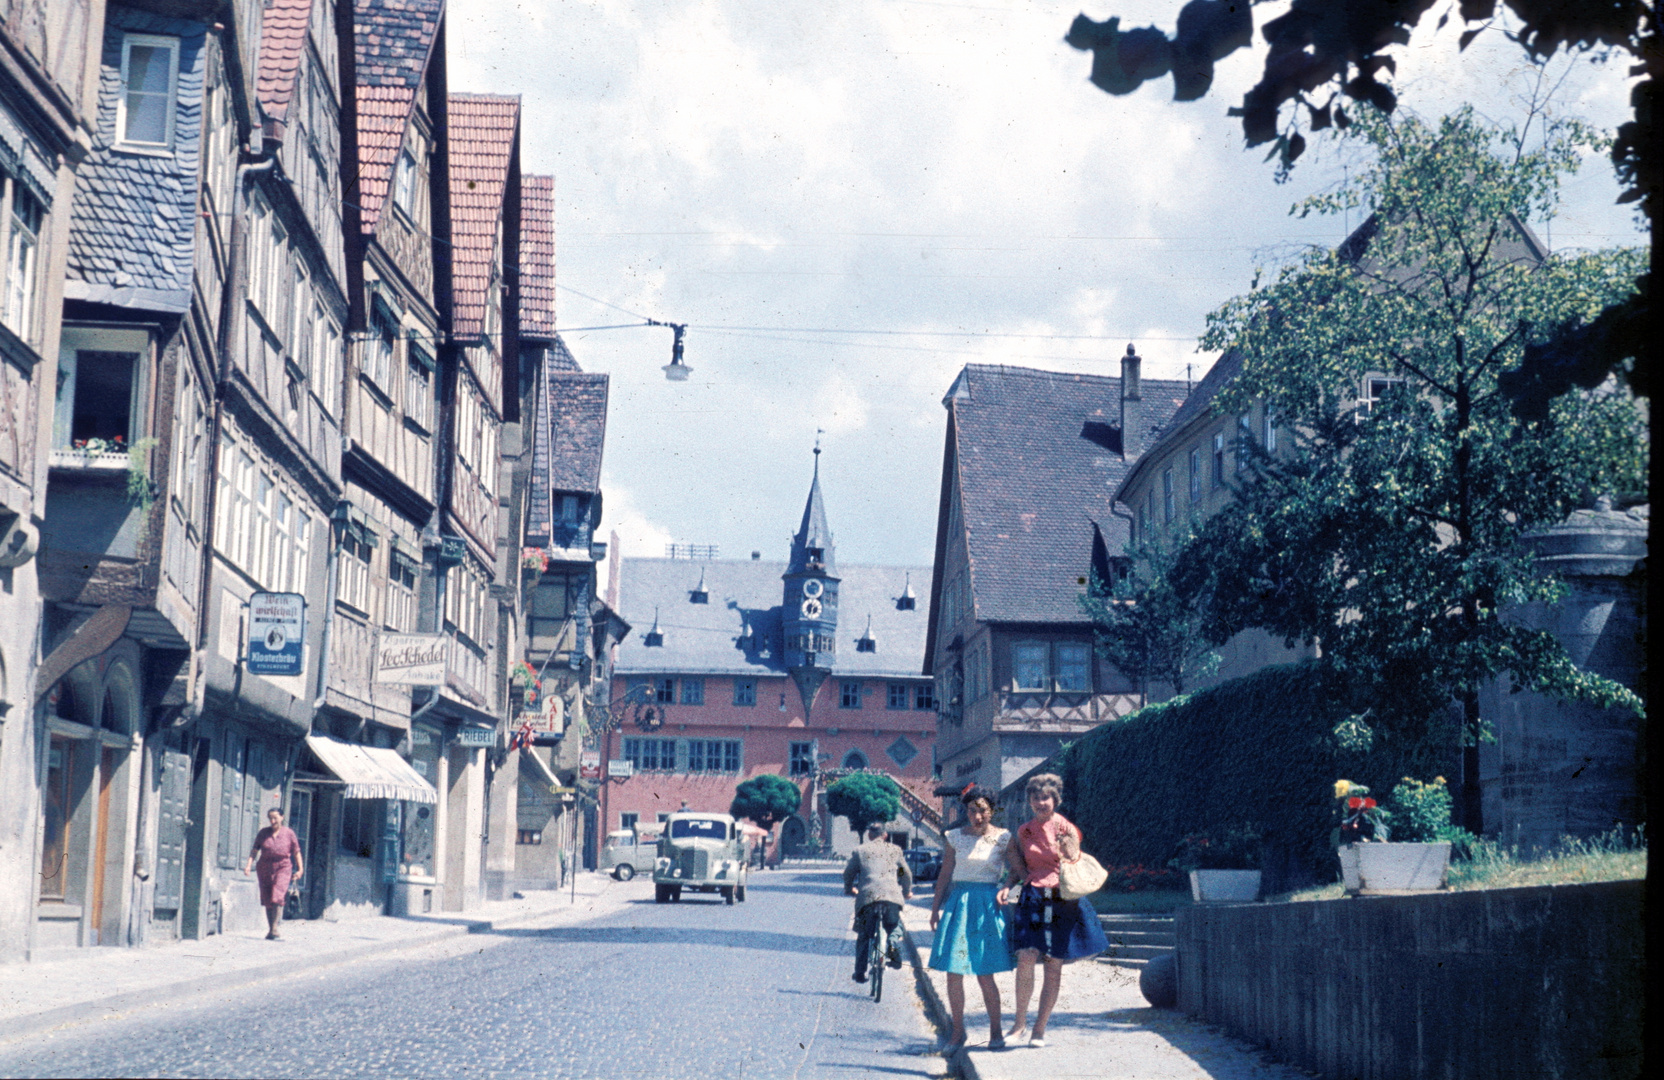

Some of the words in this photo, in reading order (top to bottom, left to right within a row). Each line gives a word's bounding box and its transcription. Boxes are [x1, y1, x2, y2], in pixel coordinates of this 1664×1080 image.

[251, 651, 296, 664] Klosterbräu
[401, 644, 447, 666] Schedel
[464, 730, 490, 743] RIEGEL
